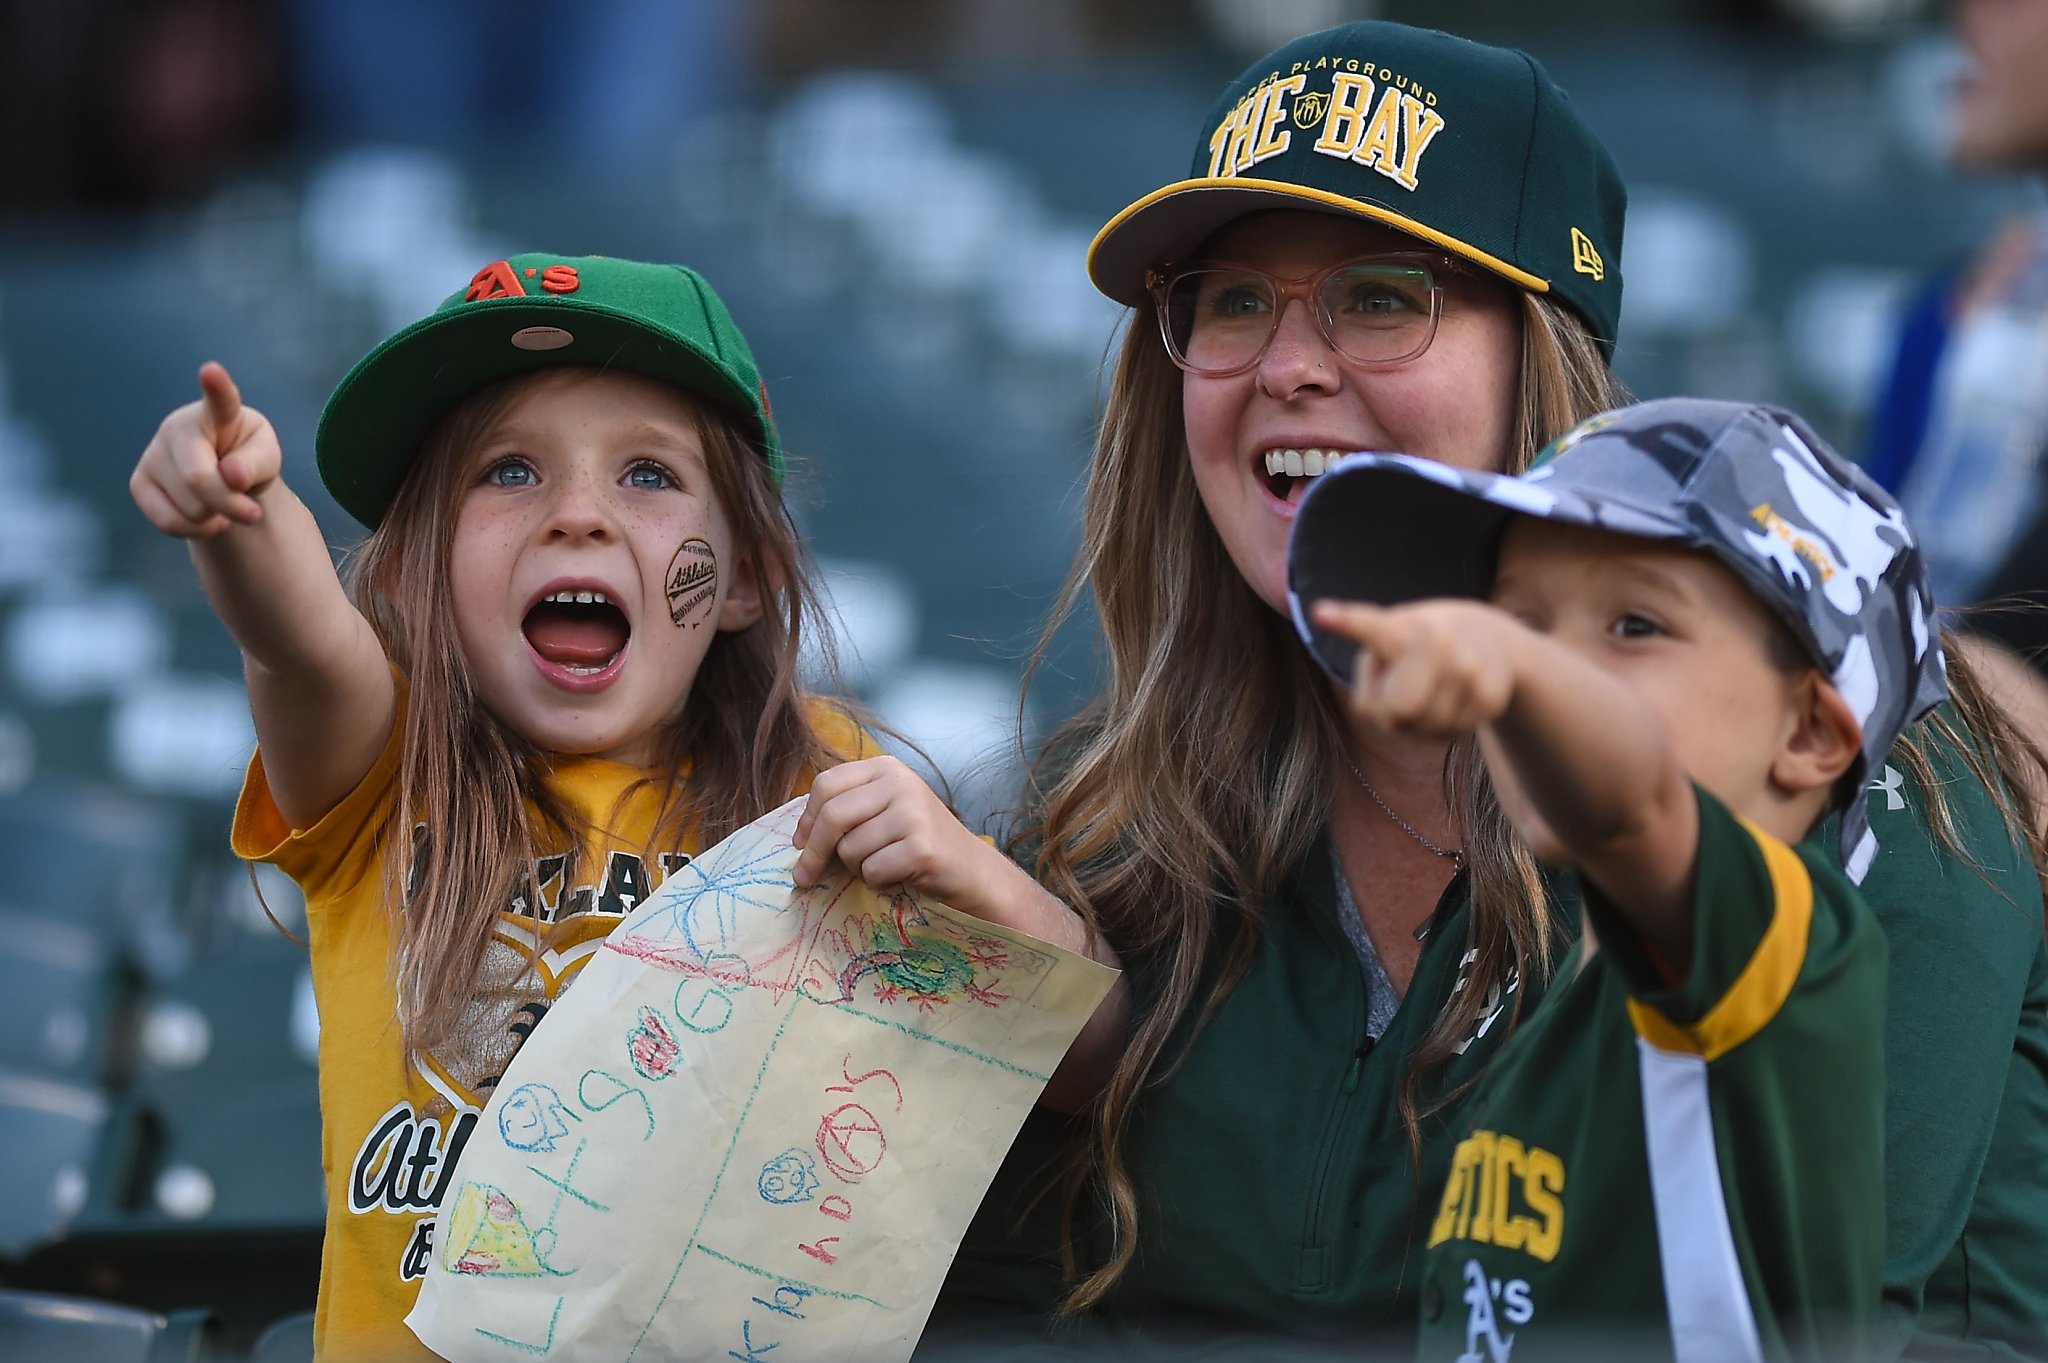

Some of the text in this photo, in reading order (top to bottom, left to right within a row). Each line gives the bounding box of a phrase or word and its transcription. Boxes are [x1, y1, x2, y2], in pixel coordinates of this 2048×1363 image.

[1291, 56, 1438, 108] PLAYGROUND
[1209, 72, 1445, 191] THE BAY
